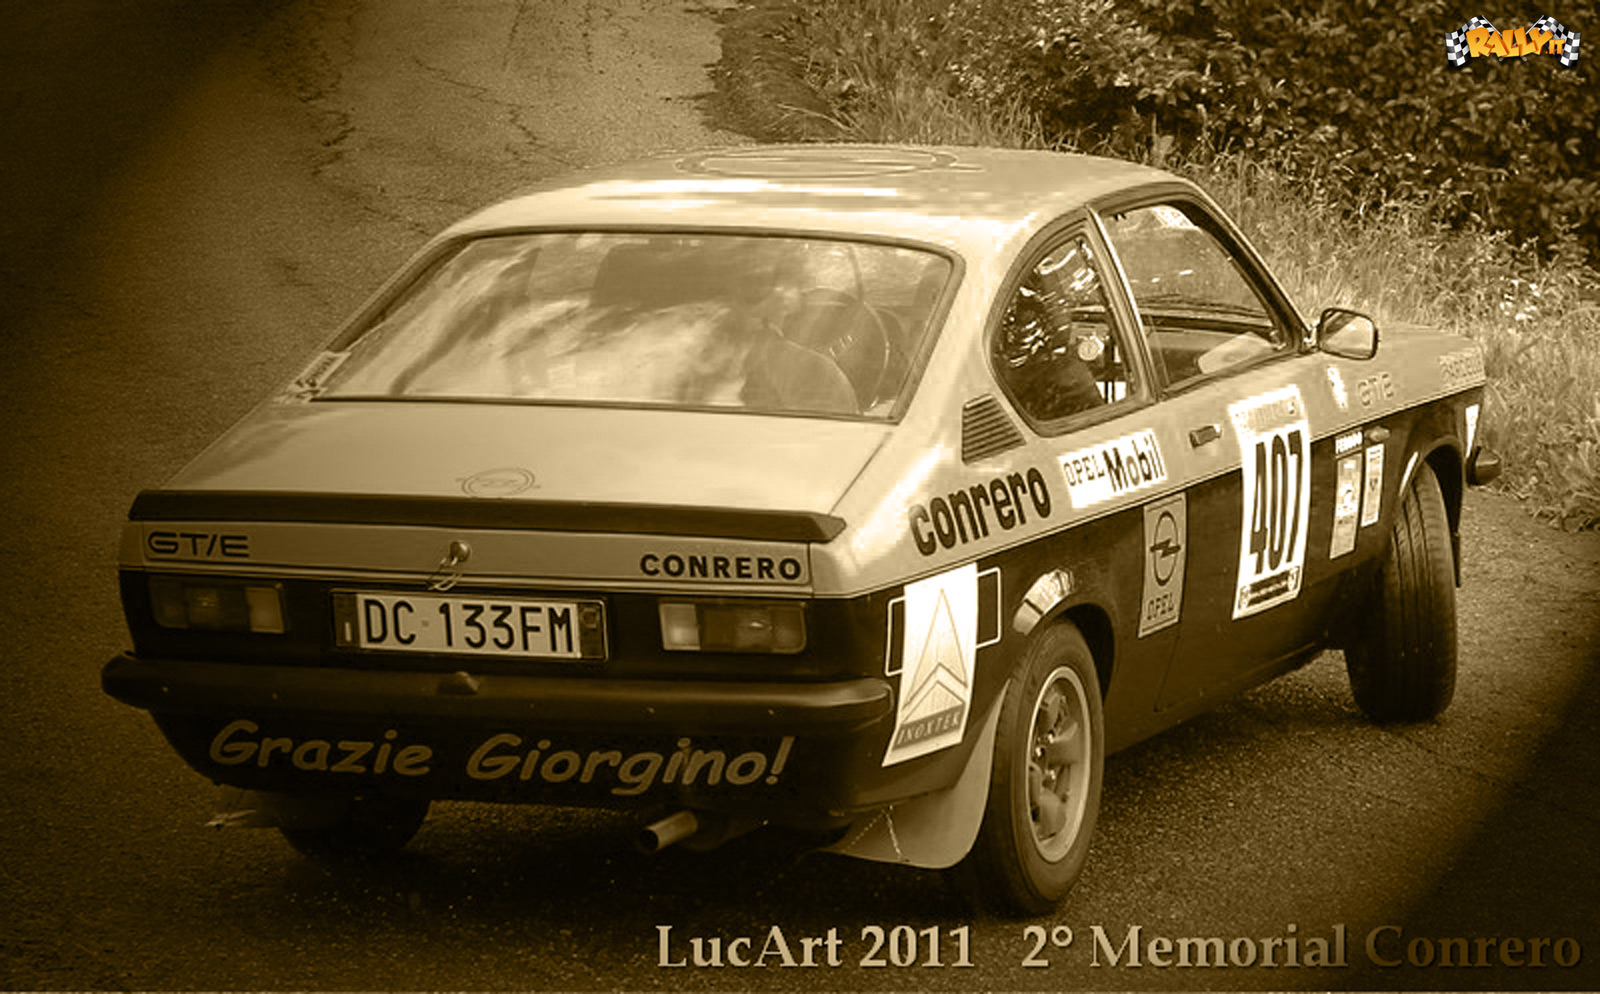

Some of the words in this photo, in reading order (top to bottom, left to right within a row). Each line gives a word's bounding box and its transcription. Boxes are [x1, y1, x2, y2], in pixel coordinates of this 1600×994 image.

[1062, 450, 1104, 487] OPEL
[1102, 433, 1165, 492] Mobil
[908, 467, 1052, 557] conrero
[1249, 429, 1303, 576] 407
[147, 531, 249, 558] GT/E
[639, 553, 802, 581] CONRERO
[364, 598, 416, 645] DC
[438, 602, 574, 654] 133FM
[1146, 591, 1175, 621] OPEL
[208, 720, 433, 777] Grazie
[466, 733, 795, 795] Giorgino!
